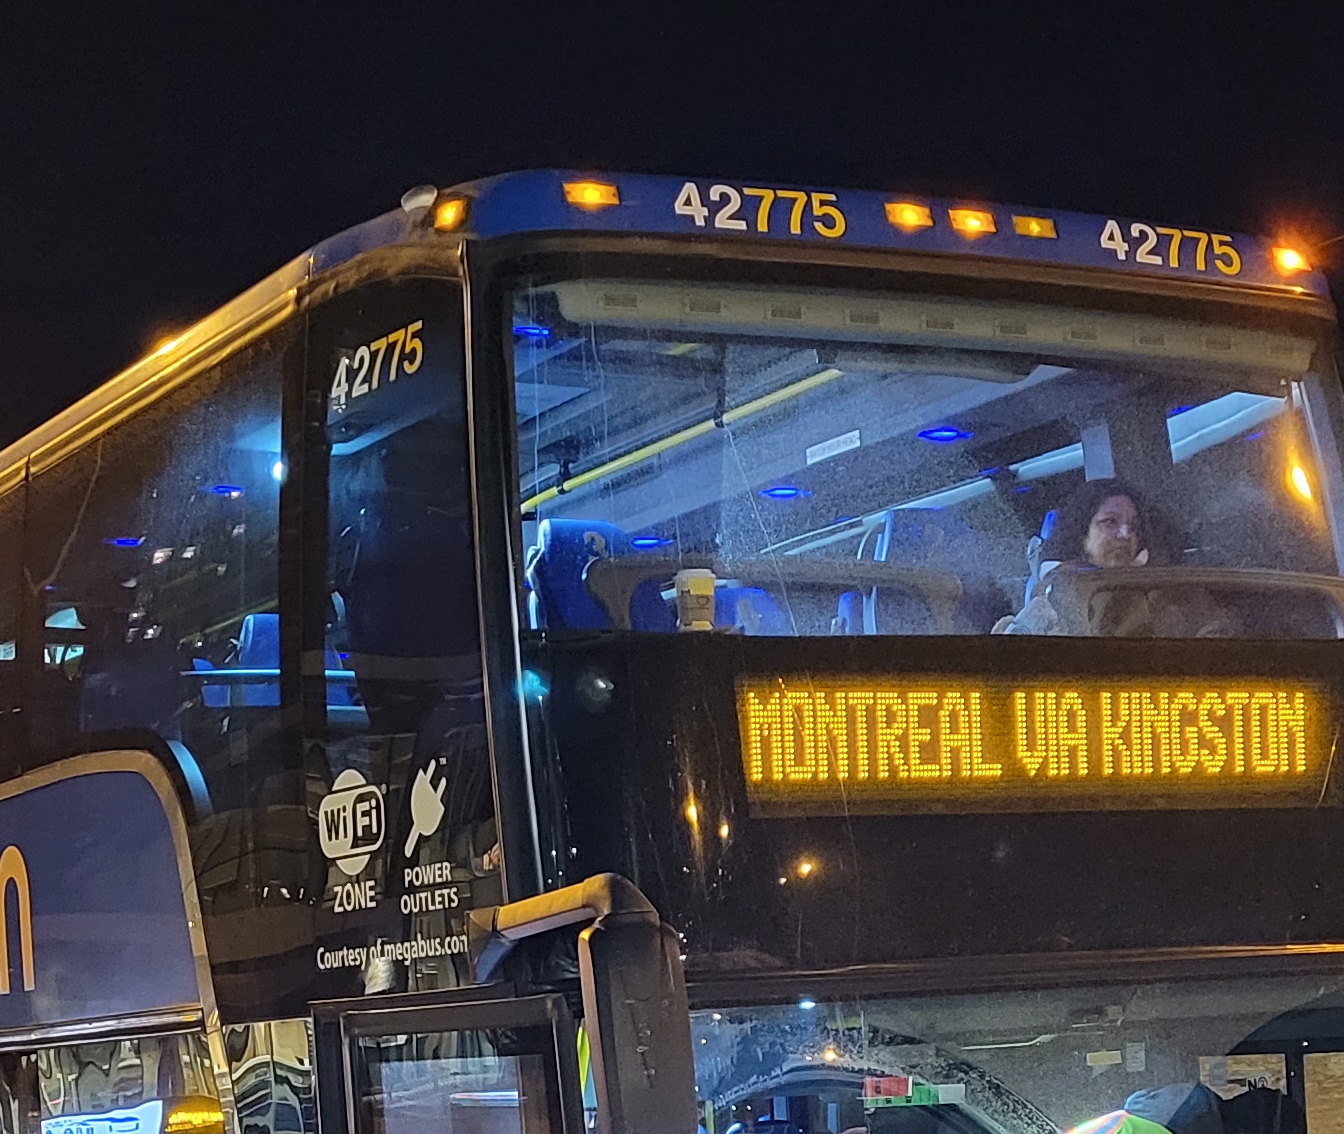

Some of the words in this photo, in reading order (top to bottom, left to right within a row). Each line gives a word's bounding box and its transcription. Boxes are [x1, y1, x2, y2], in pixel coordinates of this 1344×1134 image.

[674, 181, 847, 238] 42775
[1099, 219, 1242, 275] 42775
[331, 319, 423, 405] 42775
[748, 691, 1003, 781] MONTREAL
[1014, 691, 1089, 778] VIA
[1100, 691, 1308, 776] KINGSTON
[323, 798, 378, 843] WiFi
[333, 880, 377, 913] ZONE
[404, 861, 452, 888] POWER
[400, 887, 458, 914] OUTLETS
[317, 945, 367, 971] Courtesy
[369, 938, 383, 962] of
